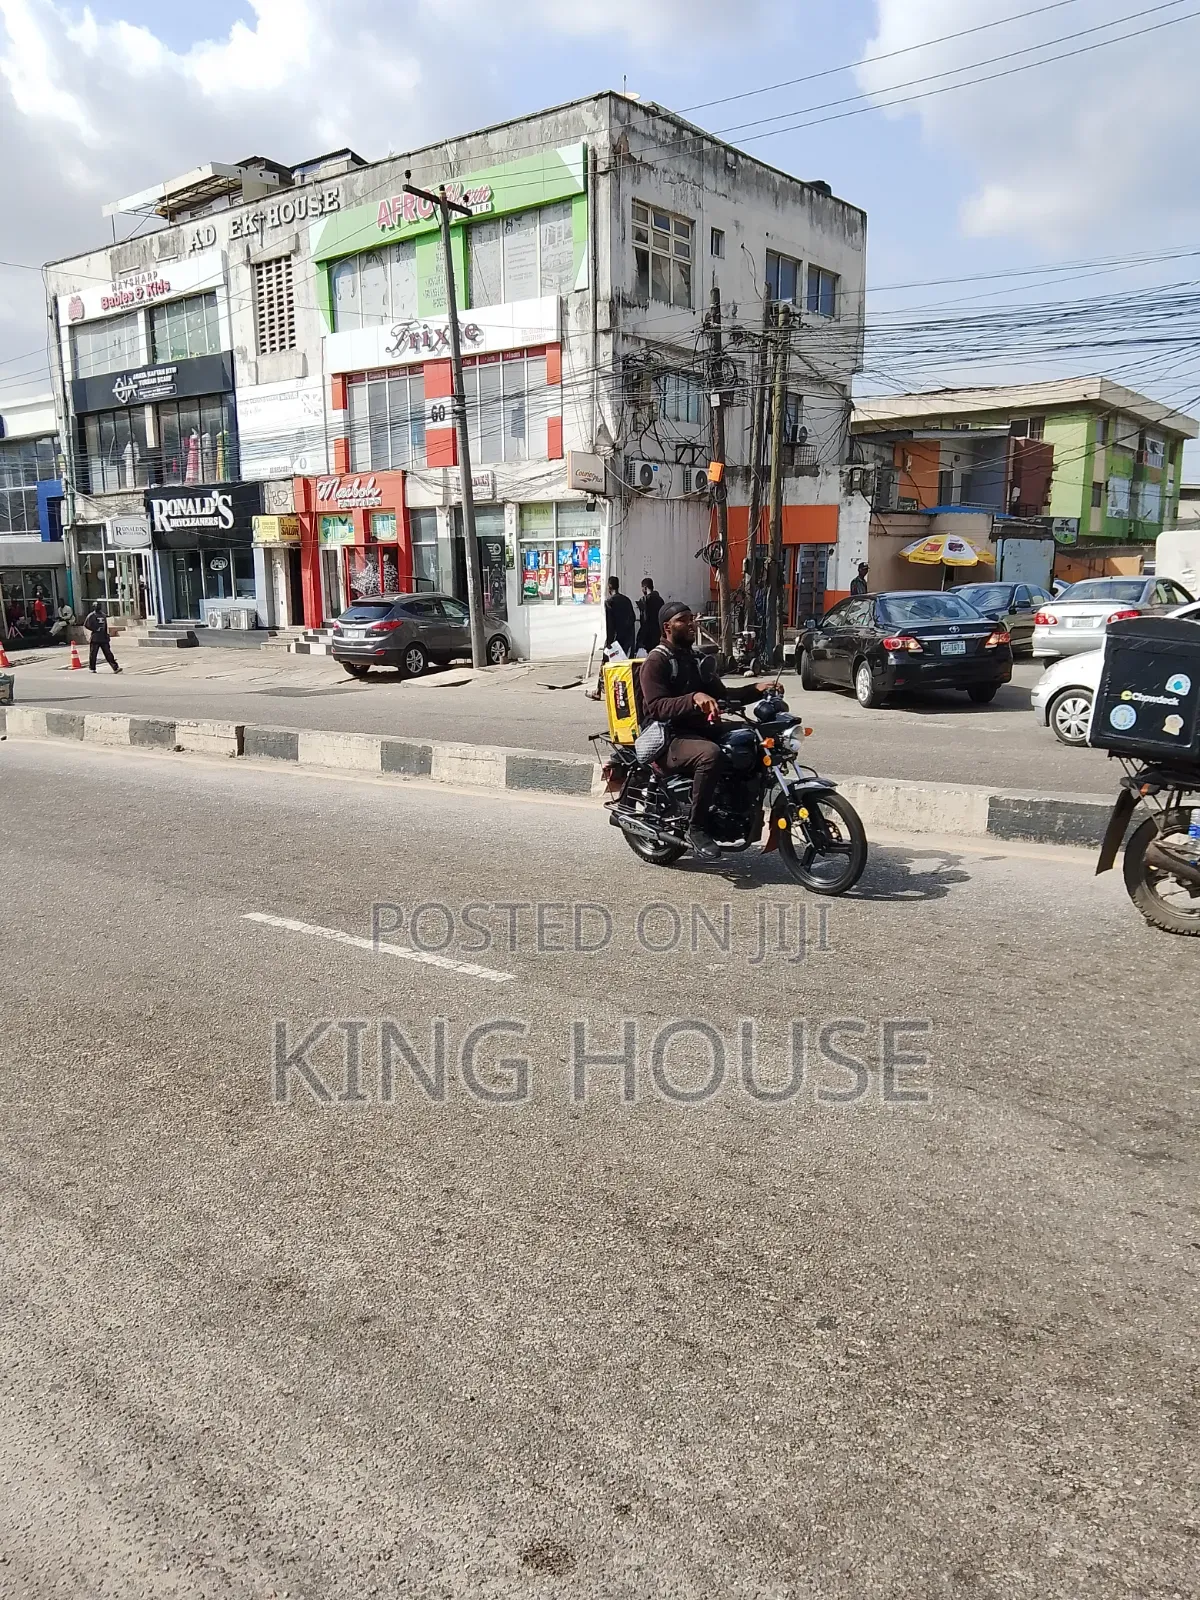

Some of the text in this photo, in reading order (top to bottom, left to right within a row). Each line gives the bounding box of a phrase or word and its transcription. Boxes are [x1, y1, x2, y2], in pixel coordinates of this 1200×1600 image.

[264, 187, 340, 229] HOUSE
[377, 189, 434, 230] AFRO
[135, 285, 145, 302] &
[146, 279, 171, 298] Kids
[431, 404, 446, 422] 60
[575, 468, 594, 478] Courier
[151, 490, 234, 532] RONALD'S
[170, 516, 219, 528] DRYCLEANERS
[115, 525, 148, 537] RONALD'S
[280, 525, 299, 536] SALON
[1131, 692, 1180, 706] Chowdeck
